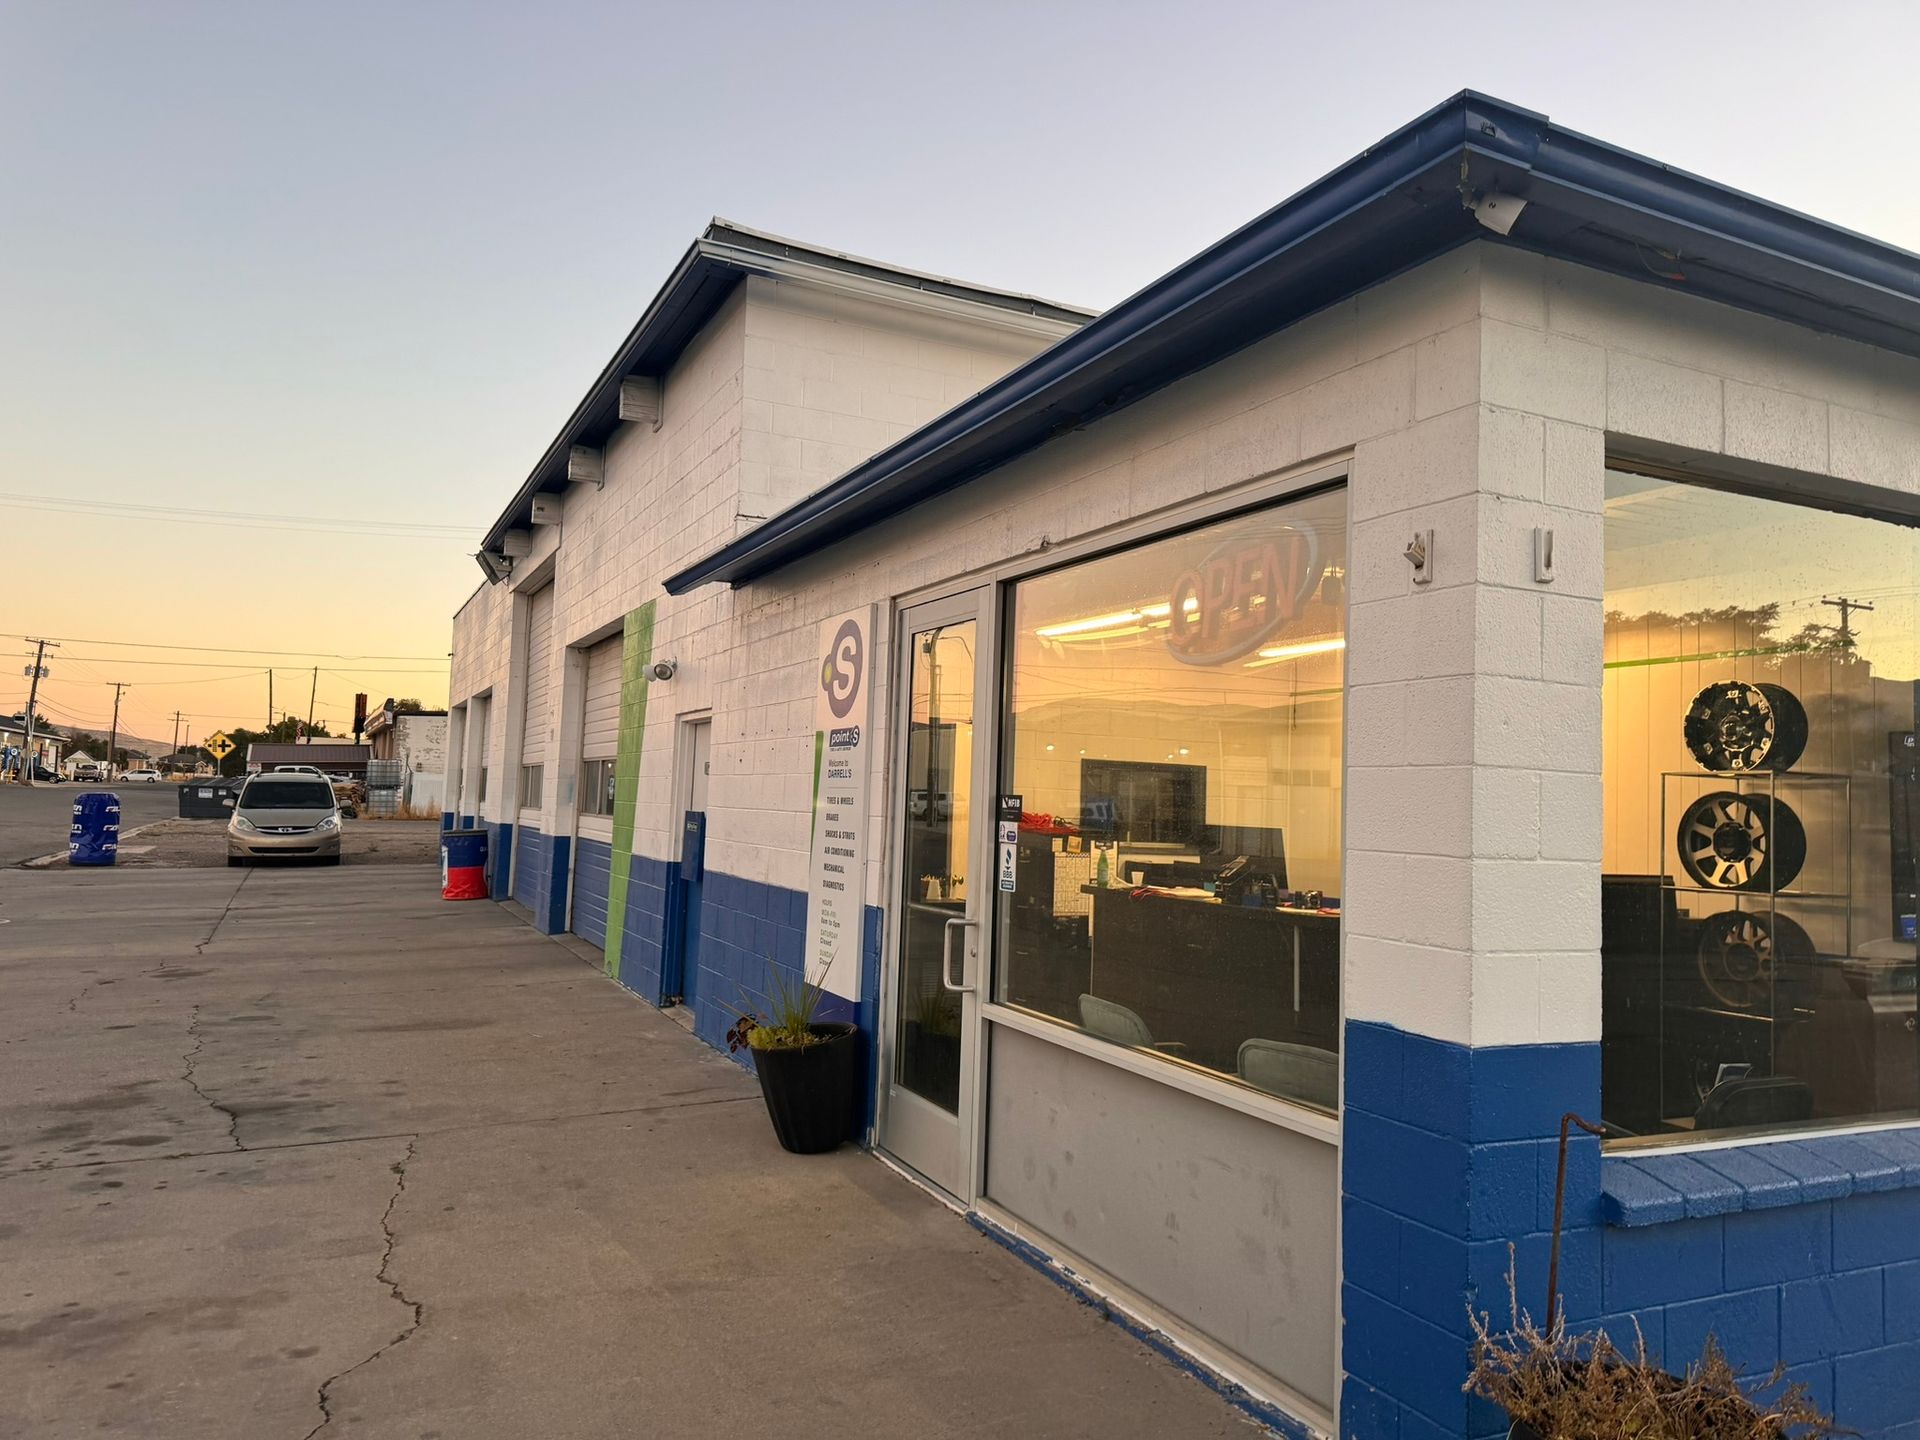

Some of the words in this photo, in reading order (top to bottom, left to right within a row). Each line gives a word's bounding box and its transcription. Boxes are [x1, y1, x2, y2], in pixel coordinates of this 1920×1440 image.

[1171, 536, 1301, 648] OPEN
[832, 635, 857, 700] S
[831, 731, 850, 745] point
